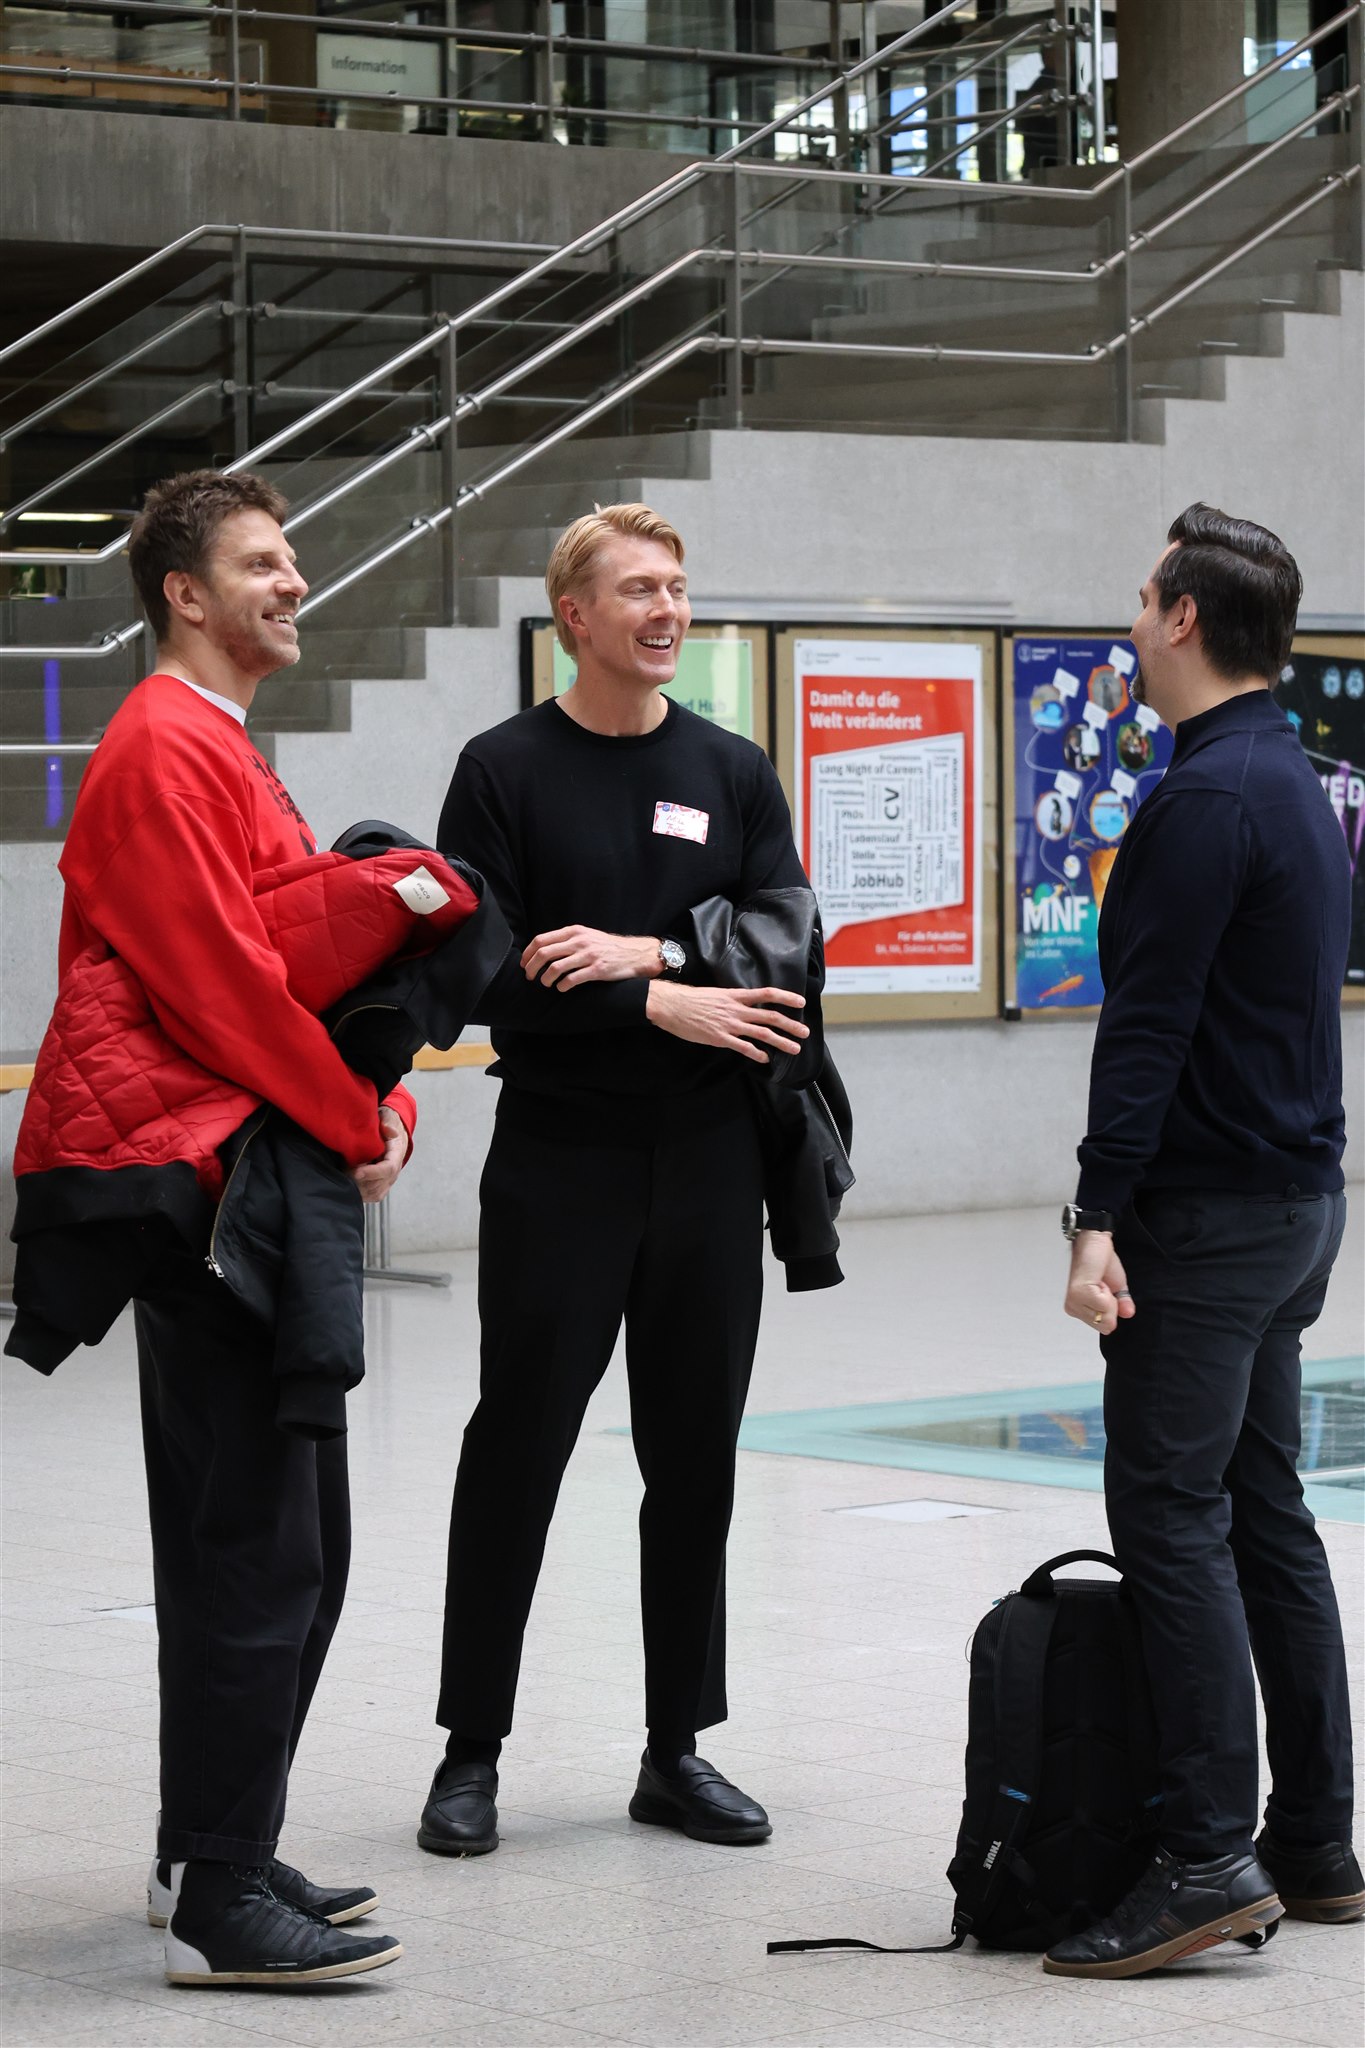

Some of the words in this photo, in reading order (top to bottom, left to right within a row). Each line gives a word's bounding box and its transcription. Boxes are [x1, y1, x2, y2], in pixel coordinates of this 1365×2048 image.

[331, 55, 407, 75] Information
[809, 689, 854, 707] Damit
[855, 691, 876, 708] du
[877, 690, 900, 708] die
[809, 711, 843, 729] Welt
[845, 713, 923, 730] veränderst
[818, 763, 843, 776] Long
[845, 763, 872, 776] Night
[874, 763, 885, 774] of
[886, 763, 924, 774] Careers
[883, 787, 900, 820] CV
[849, 833, 900, 843] Lebenslauf
[852, 850, 876, 859] Stelle
[851, 873, 904, 888] JobHub
[1023, 895, 1089, 934] MNF
[983, 1840, 1002, 1870] THULE
